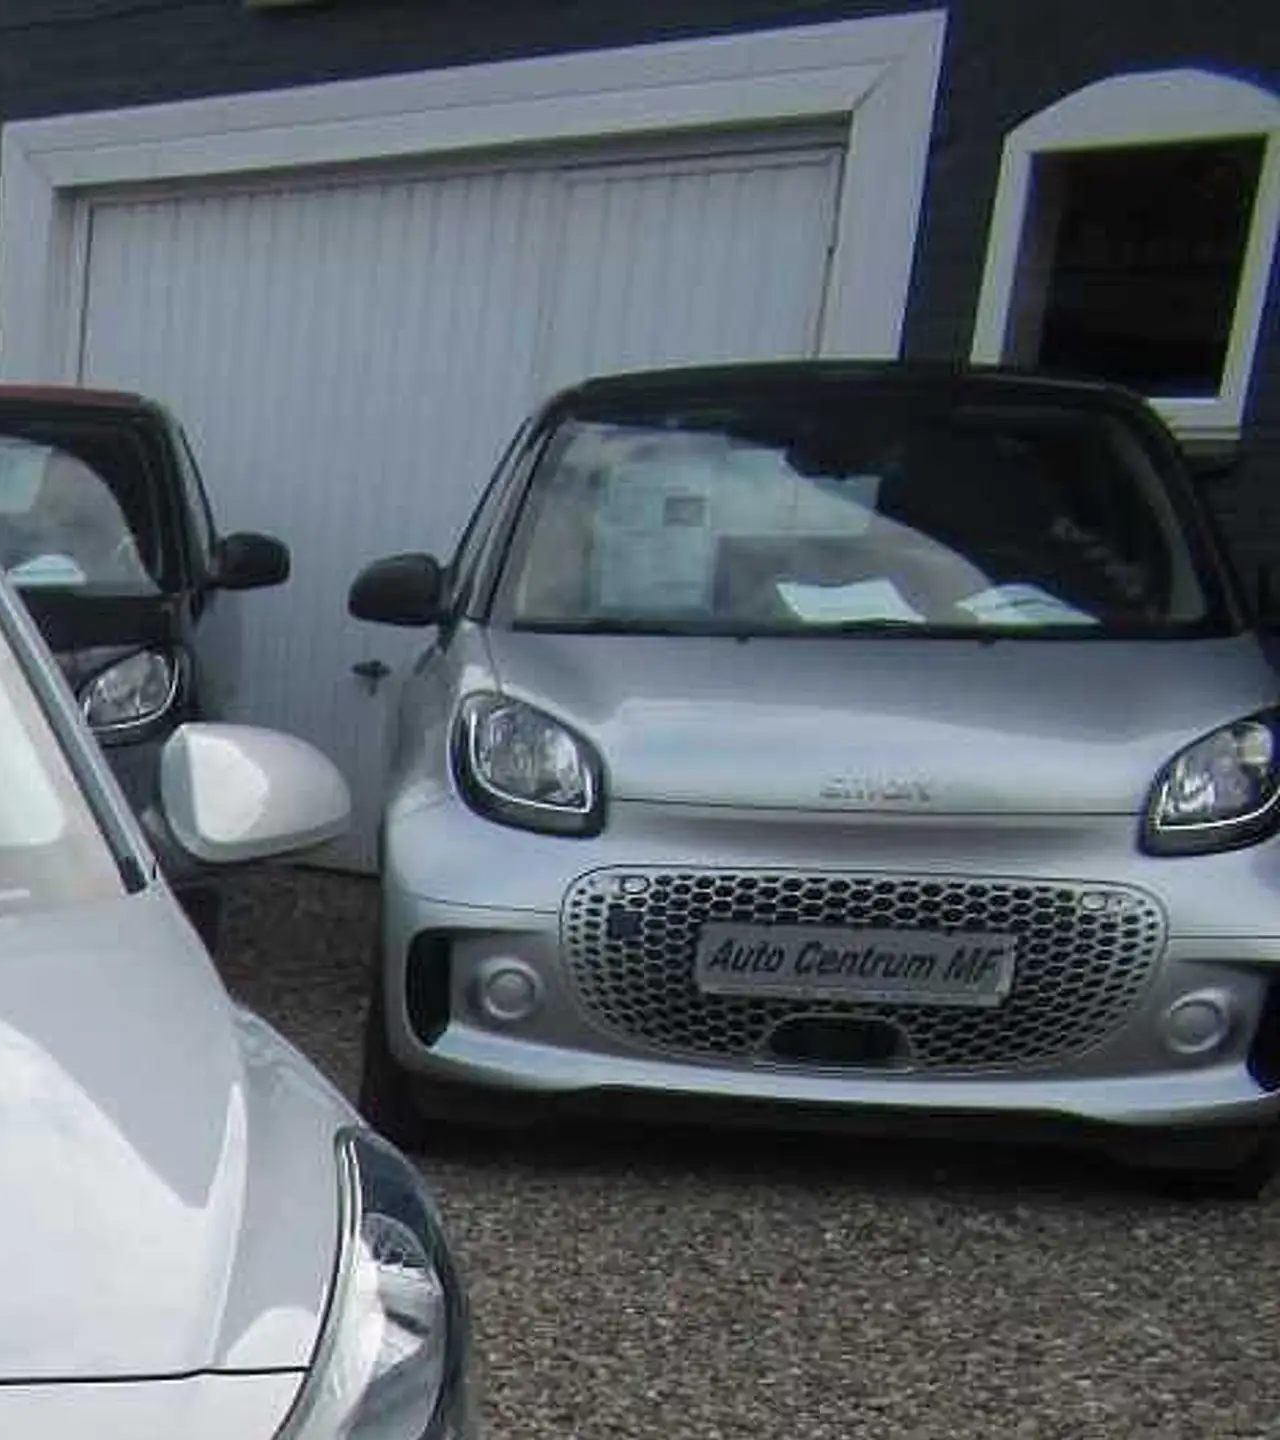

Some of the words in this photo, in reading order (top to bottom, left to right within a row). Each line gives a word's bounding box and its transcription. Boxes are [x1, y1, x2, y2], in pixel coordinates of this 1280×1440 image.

[708, 937, 786, 973] Auto
[794, 940, 937, 979] Centrum
[942, 944, 1006, 985] MF
